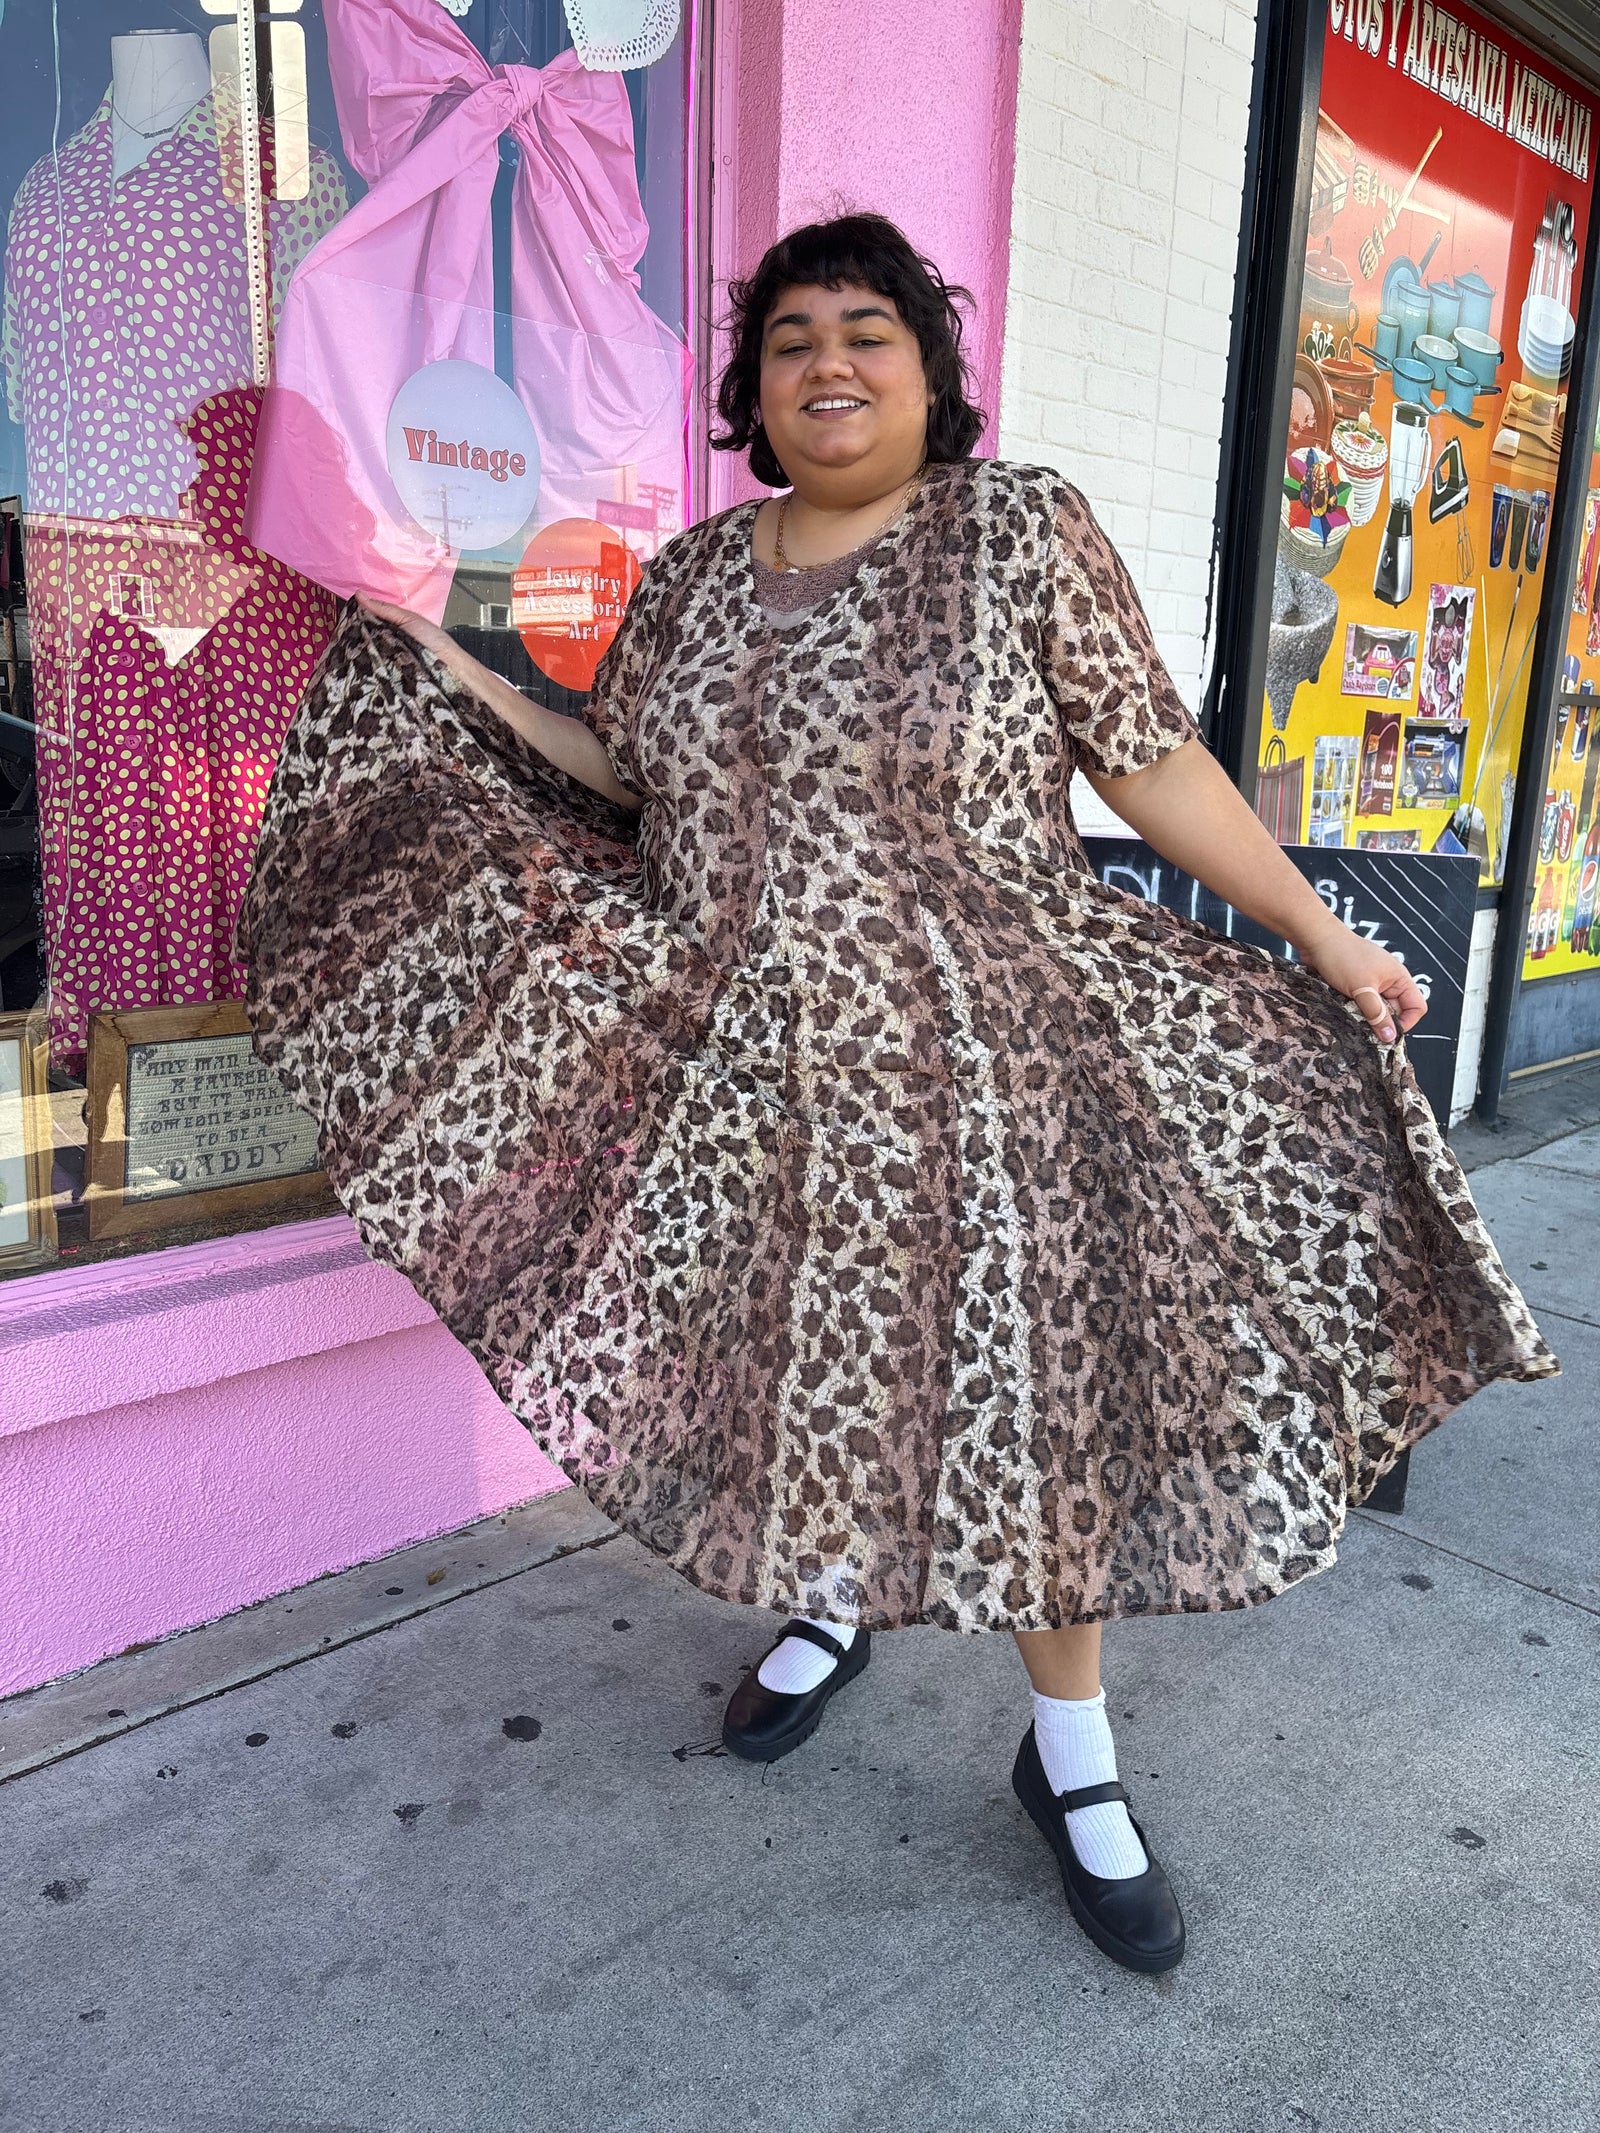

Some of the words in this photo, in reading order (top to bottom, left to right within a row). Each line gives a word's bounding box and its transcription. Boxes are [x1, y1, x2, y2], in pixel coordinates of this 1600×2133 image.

[1387, 0, 1405, 69] Y
[1402, 0, 1508, 133] ARTESANIA
[1506, 59, 1593, 183] MEXICANA
[402, 427, 526, 482] Vintage
[545, 566, 621, 597] Jewelry
[524, 590, 627, 618] Accessori
[568, 620, 600, 641] Art
[244, 1085, 293, 1102] TAKE
[139, 1111, 233, 1136] SOMEONE
[195, 1132, 219, 1148] TO
[227, 1127, 249, 1143] BE
[256, 1124, 269, 1139] A
